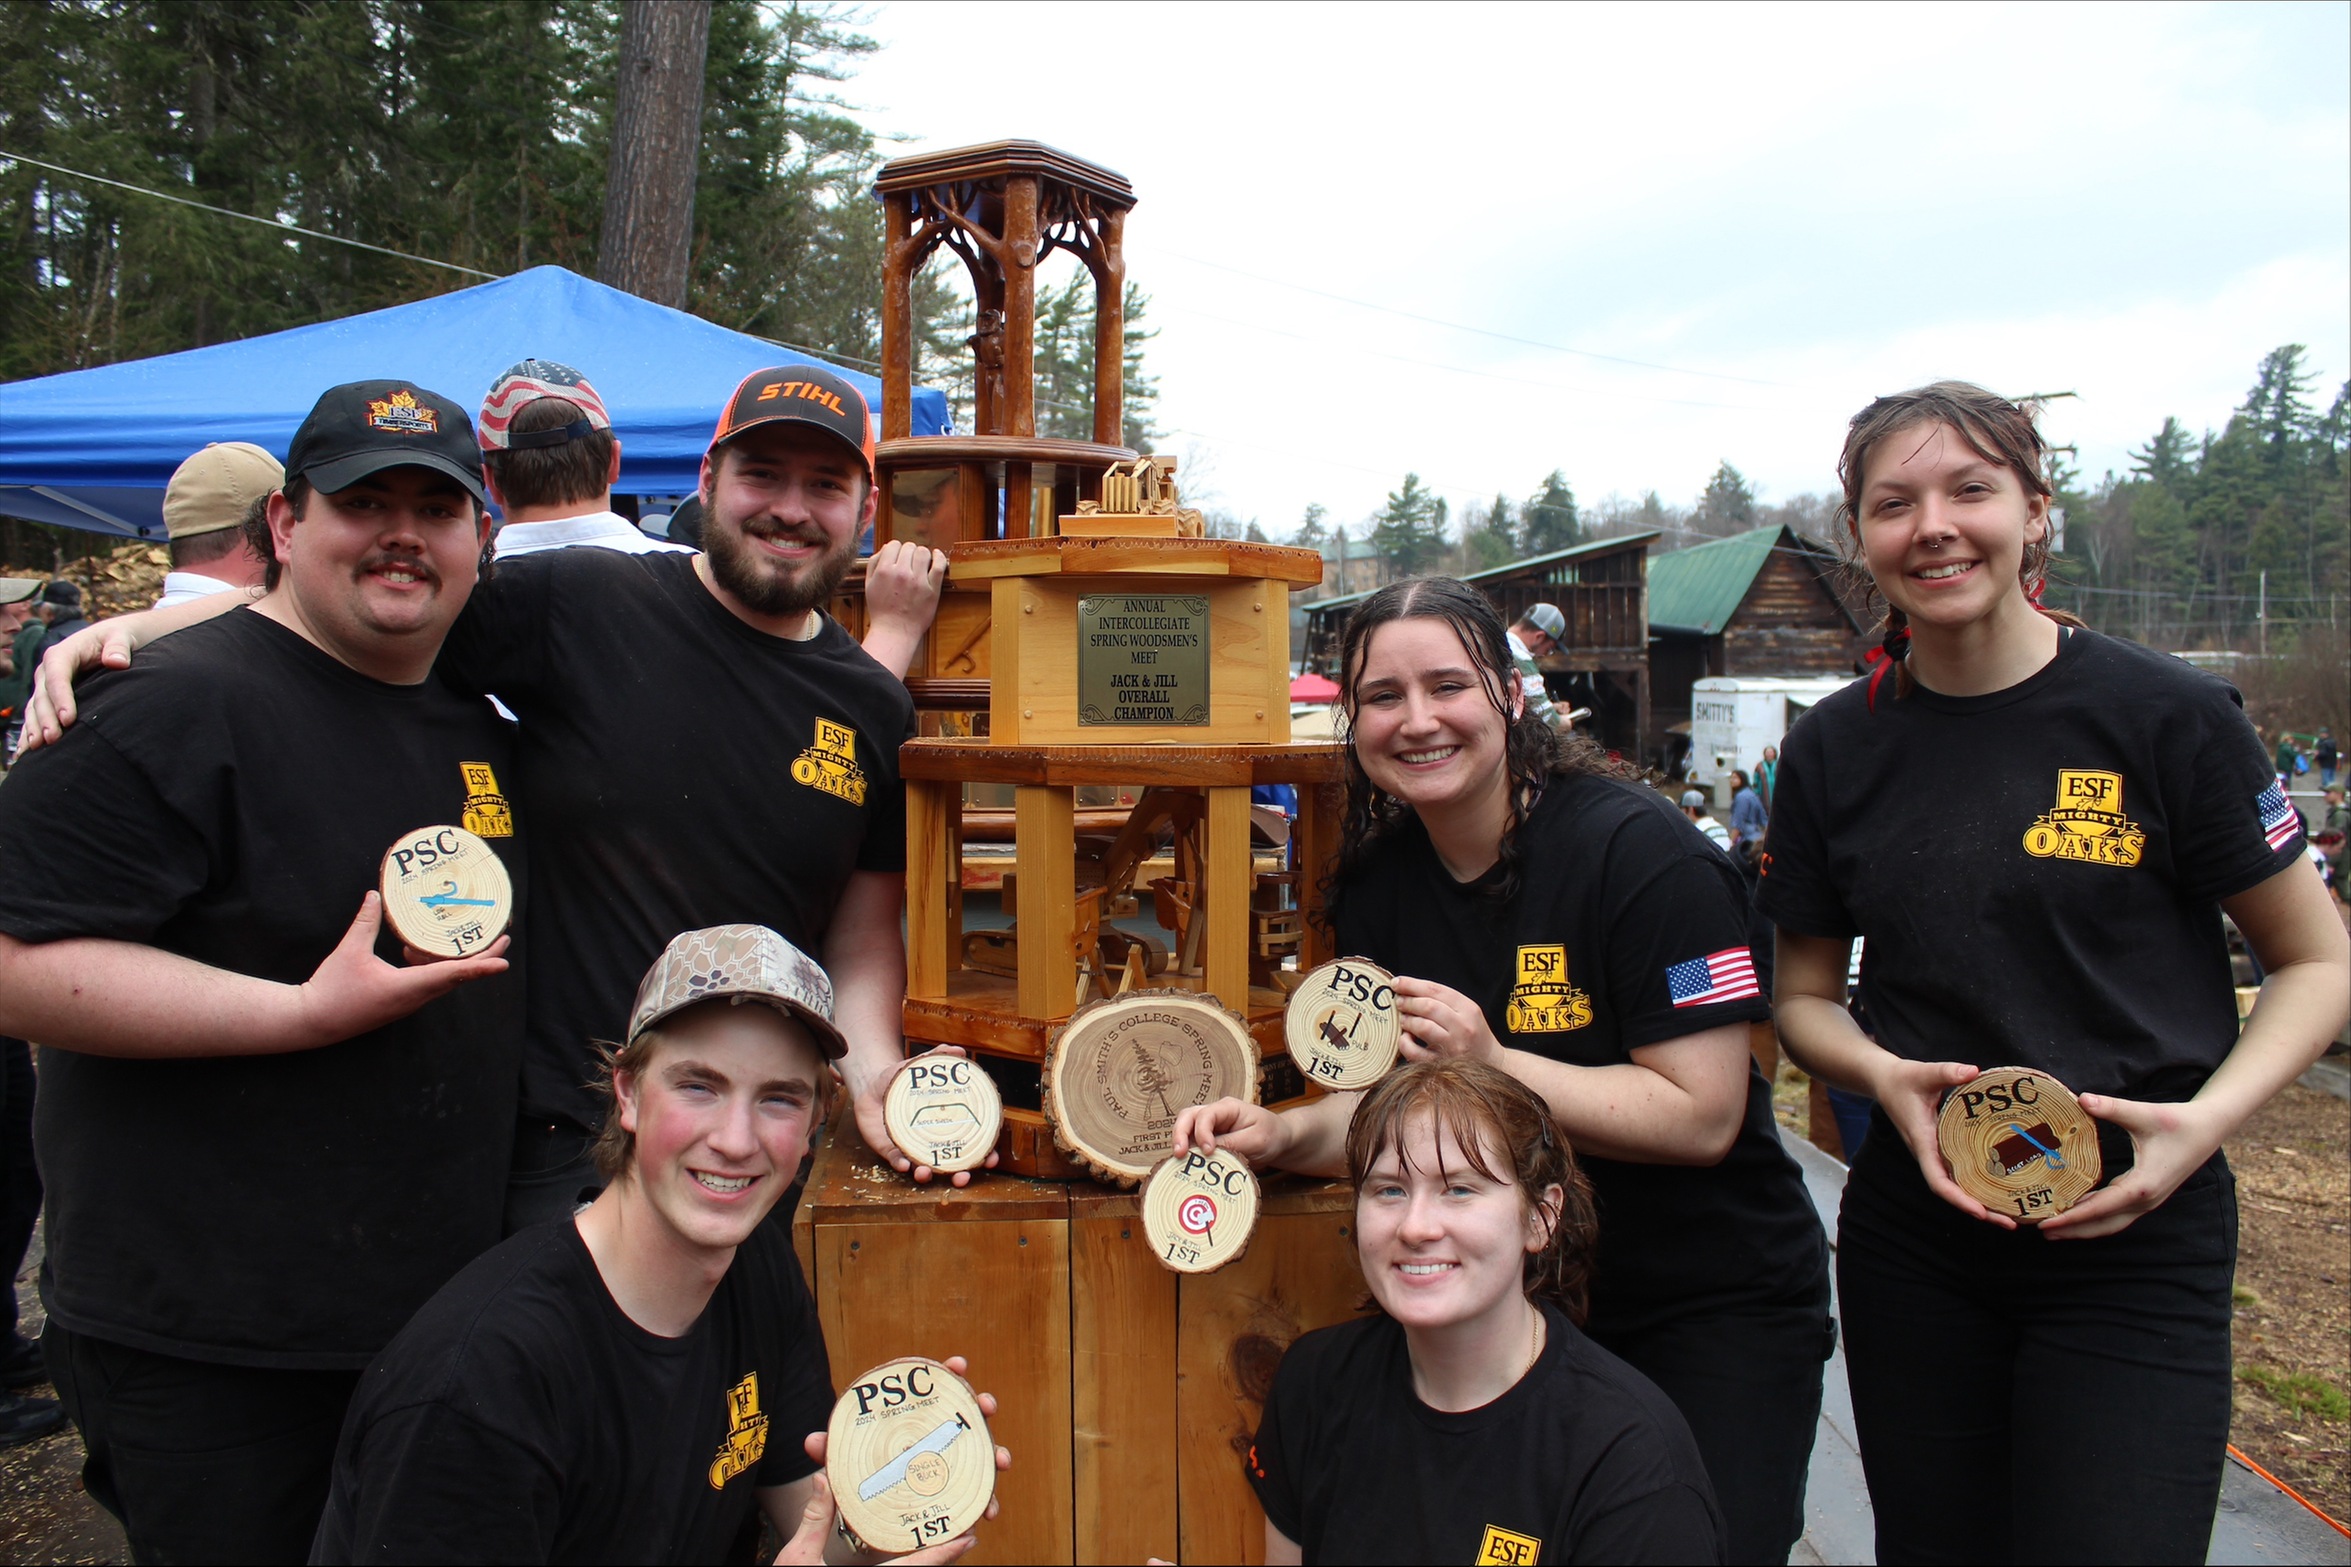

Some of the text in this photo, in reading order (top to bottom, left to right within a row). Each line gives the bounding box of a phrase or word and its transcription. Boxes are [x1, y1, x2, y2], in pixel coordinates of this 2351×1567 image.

[757, 381, 846, 417] STIHL
[1123, 600, 1166, 613] ANNUAL
[1099, 617, 1190, 630] INTERCOLLEGIATE
[1090, 634, 1198, 647] SPRING WOODSMEN'S
[1131, 651, 1158, 664] MEET
[1110, 674, 1178, 688] JACK & JILL
[1118, 690, 1170, 703] OVERALL
[1114, 706, 1175, 720] CHAMPION
[1696, 702, 1735, 723] SMITTY'S
[822, 725, 850, 747] ESF
[812, 750, 857, 770] MIGHTY
[468, 768, 490, 785] ESF
[791, 757, 868, 806] OAKS
[2067, 777, 2114, 799] ESF
[470, 796, 503, 805] MIGHTY
[2053, 811, 2124, 826] MIGHTY
[391, 829, 460, 877] PSC
[2022, 824, 2147, 868] OAKS
[451, 925, 484, 956] 1ST
[1523, 952, 1561, 972] ESF
[1328, 965, 1396, 1011] PSC
[1516, 985, 1569, 996] MIGHTY
[1118, 1013, 1181, 1032] COLLEGE
[1506, 995, 1594, 1034] OAKS
[1096, 1030, 1119, 1085] SMITH'S
[1181, 1023, 1213, 1070] SPRING
[908, 1062, 971, 1090] PSC
[1306, 1057, 1344, 1080] 1ST
[1103, 1087, 1129, 1119] PAUL
[1959, 1077, 2039, 1120] PSC
[1119, 1141, 1172, 1155] JACK & JILL
[1133, 1131, 1161, 1143] FIRST
[931, 1146, 962, 1167] 1ST
[1180, 1150, 1248, 1196] PSC
[1193, 1181, 1219, 1196] SPRING
[2013, 1189, 2053, 1217] 1ST
[1164, 1243, 1201, 1265] 1ST
[852, 1365, 934, 1416] PSC
[855, 1396, 940, 1427] 2024 SPRING MEET
[908, 1458, 941, 1474] SINGLE
[916, 1469, 941, 1482] BUCK
[898, 1503, 951, 1528] JACK & JILL
[911, 1515, 951, 1550] 1ST
[1488, 1535, 1530, 1565] ESF
